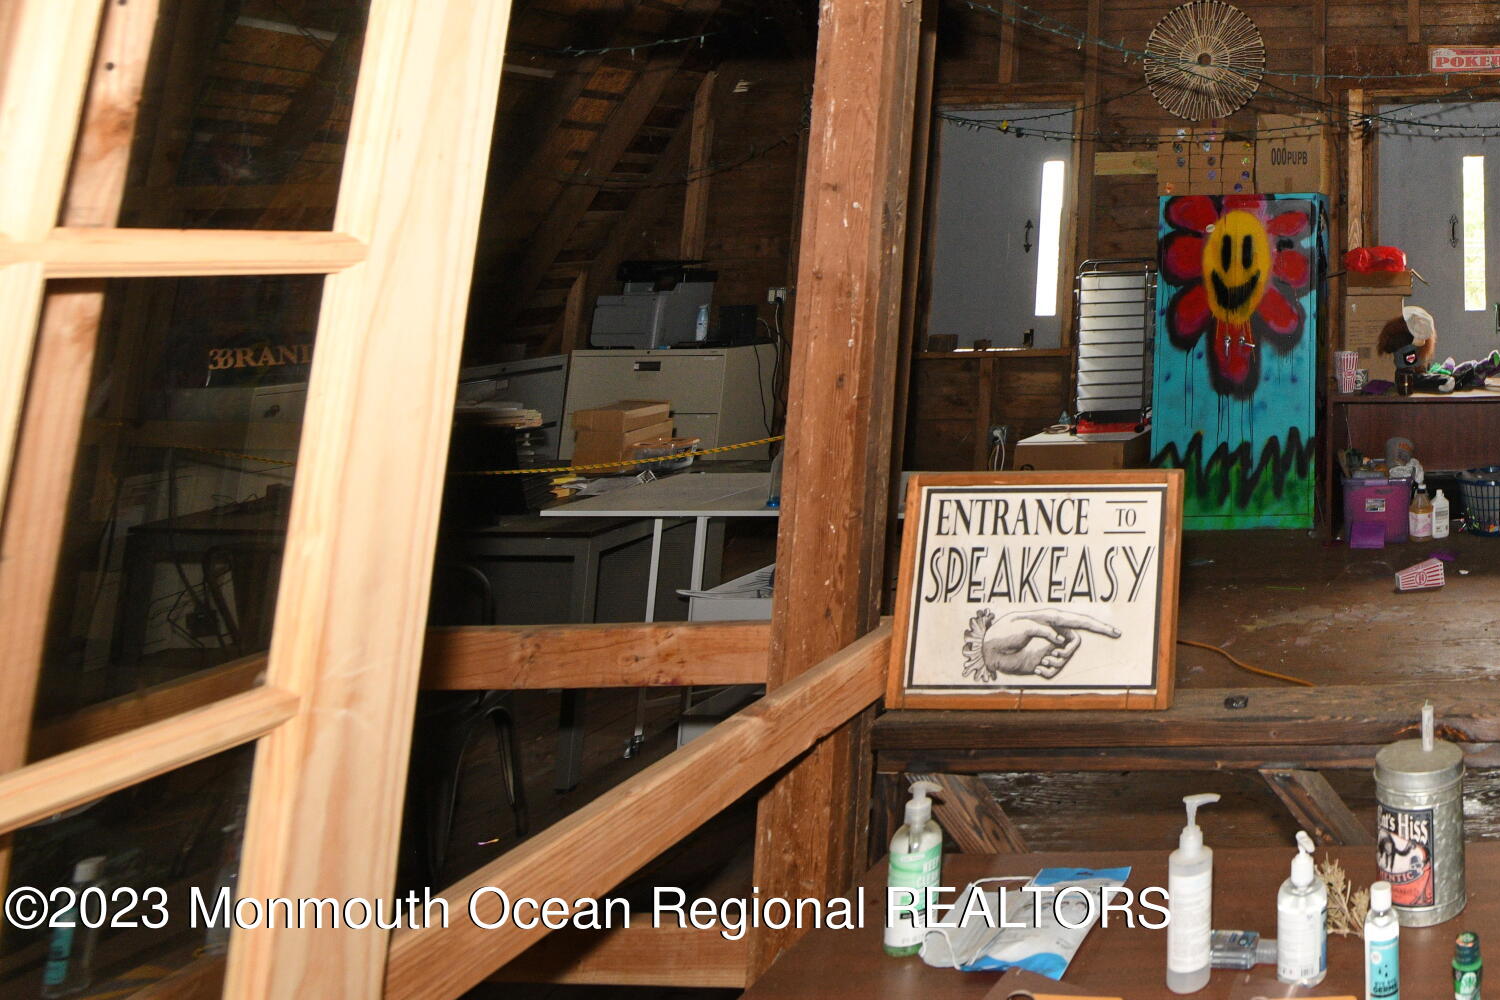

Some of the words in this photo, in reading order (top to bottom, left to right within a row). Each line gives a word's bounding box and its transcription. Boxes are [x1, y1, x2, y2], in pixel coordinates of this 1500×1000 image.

[935, 498, 1090, 536] ENTRANCE
[1115, 508, 1137, 527] TO
[925, 545, 1155, 604] SPEAKEASY
[1398, 813, 1429, 845] Hiss
